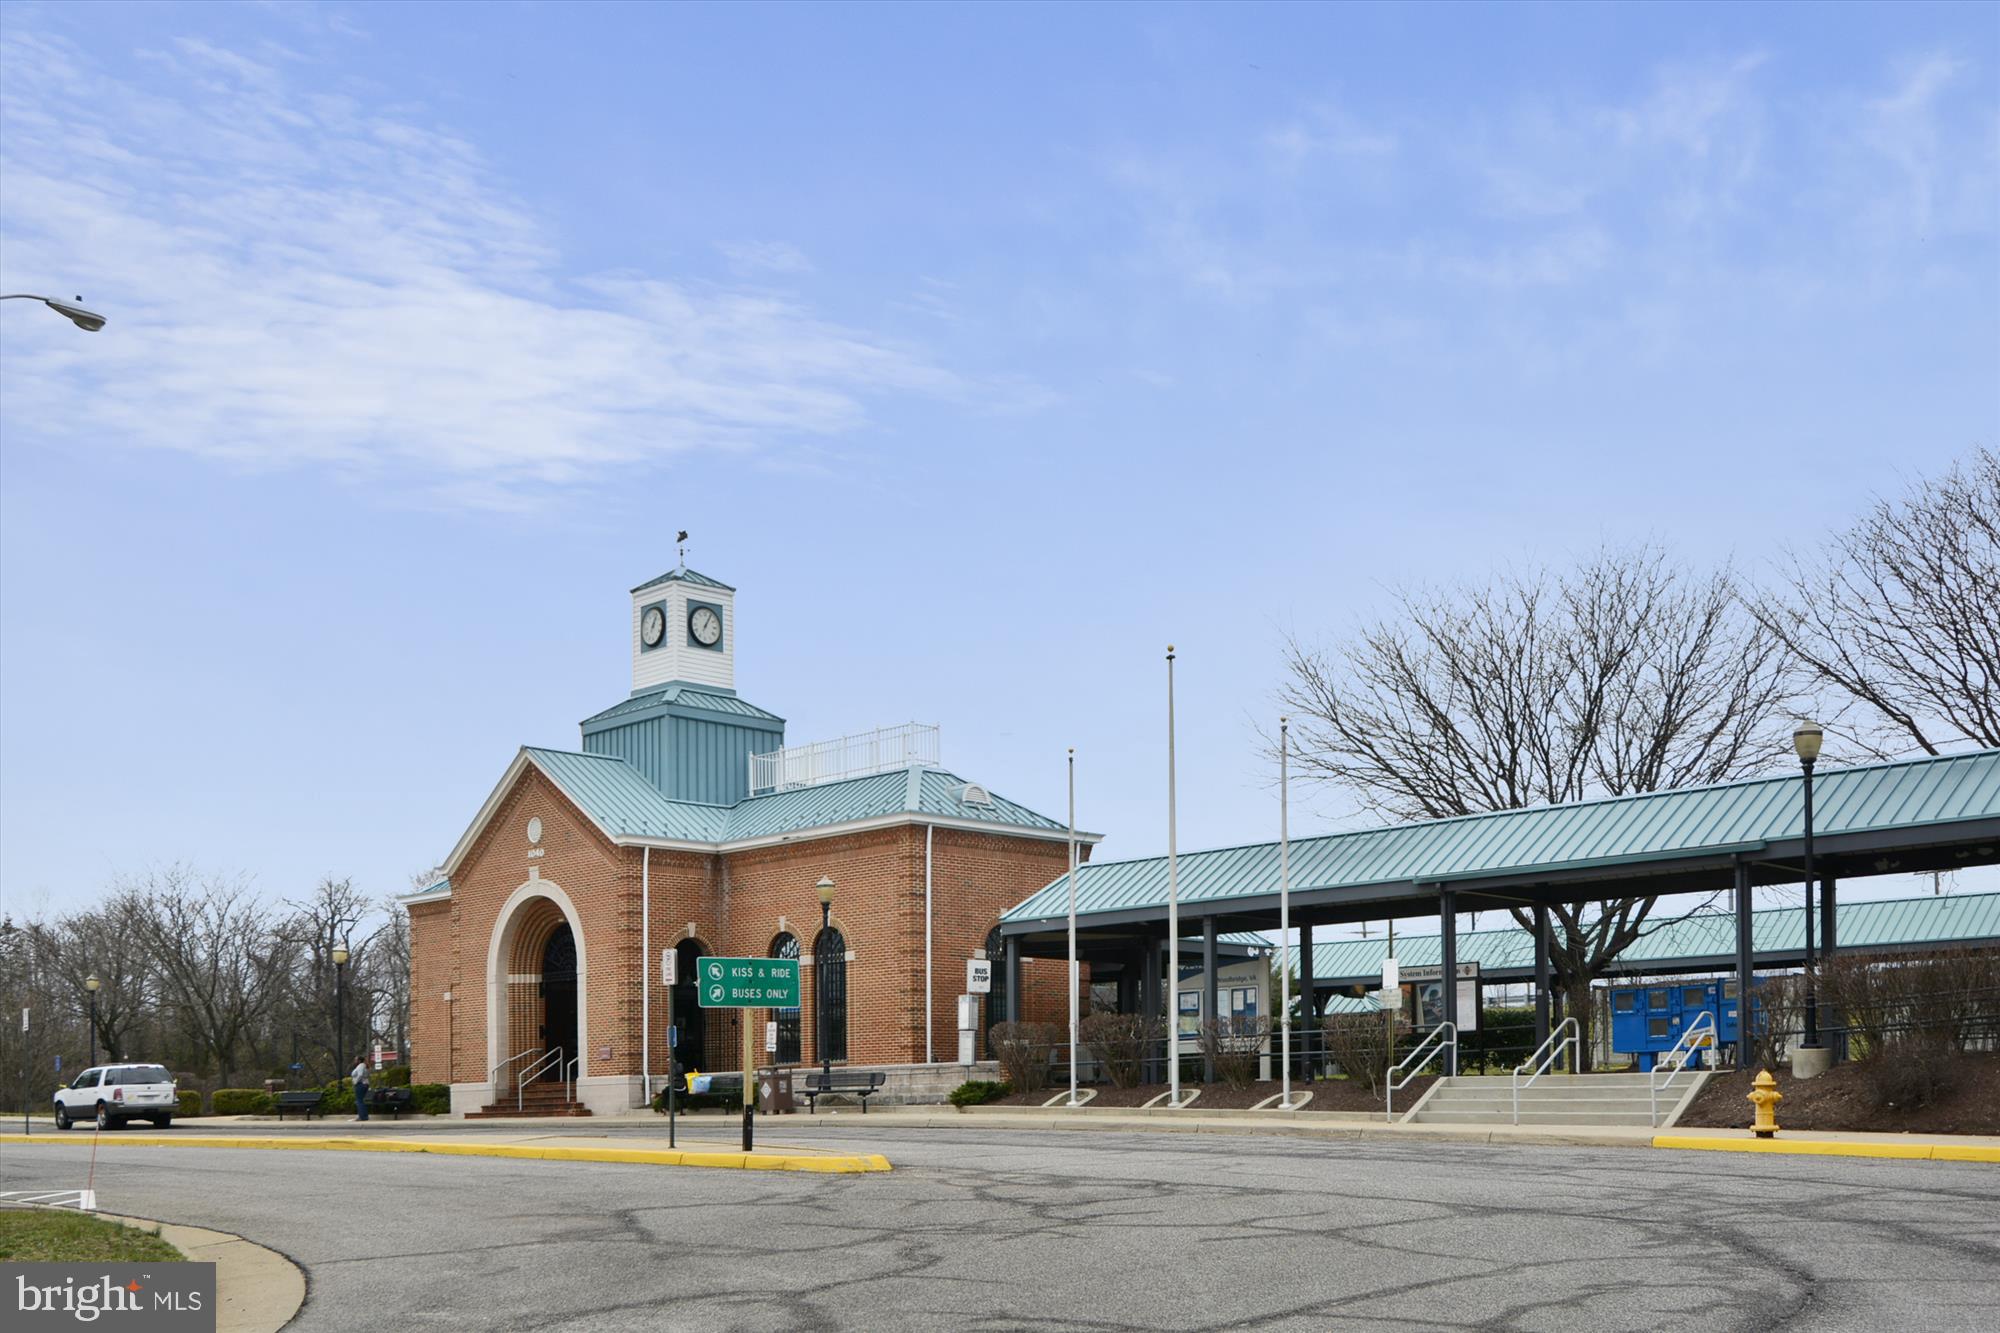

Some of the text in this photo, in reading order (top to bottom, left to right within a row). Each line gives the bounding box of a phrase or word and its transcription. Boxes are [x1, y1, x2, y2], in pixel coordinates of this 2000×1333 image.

[731, 967, 791, 978] KISS & RIDE
[974, 967, 988, 975] BUS
[732, 988, 789, 999] BUSES ONLY
